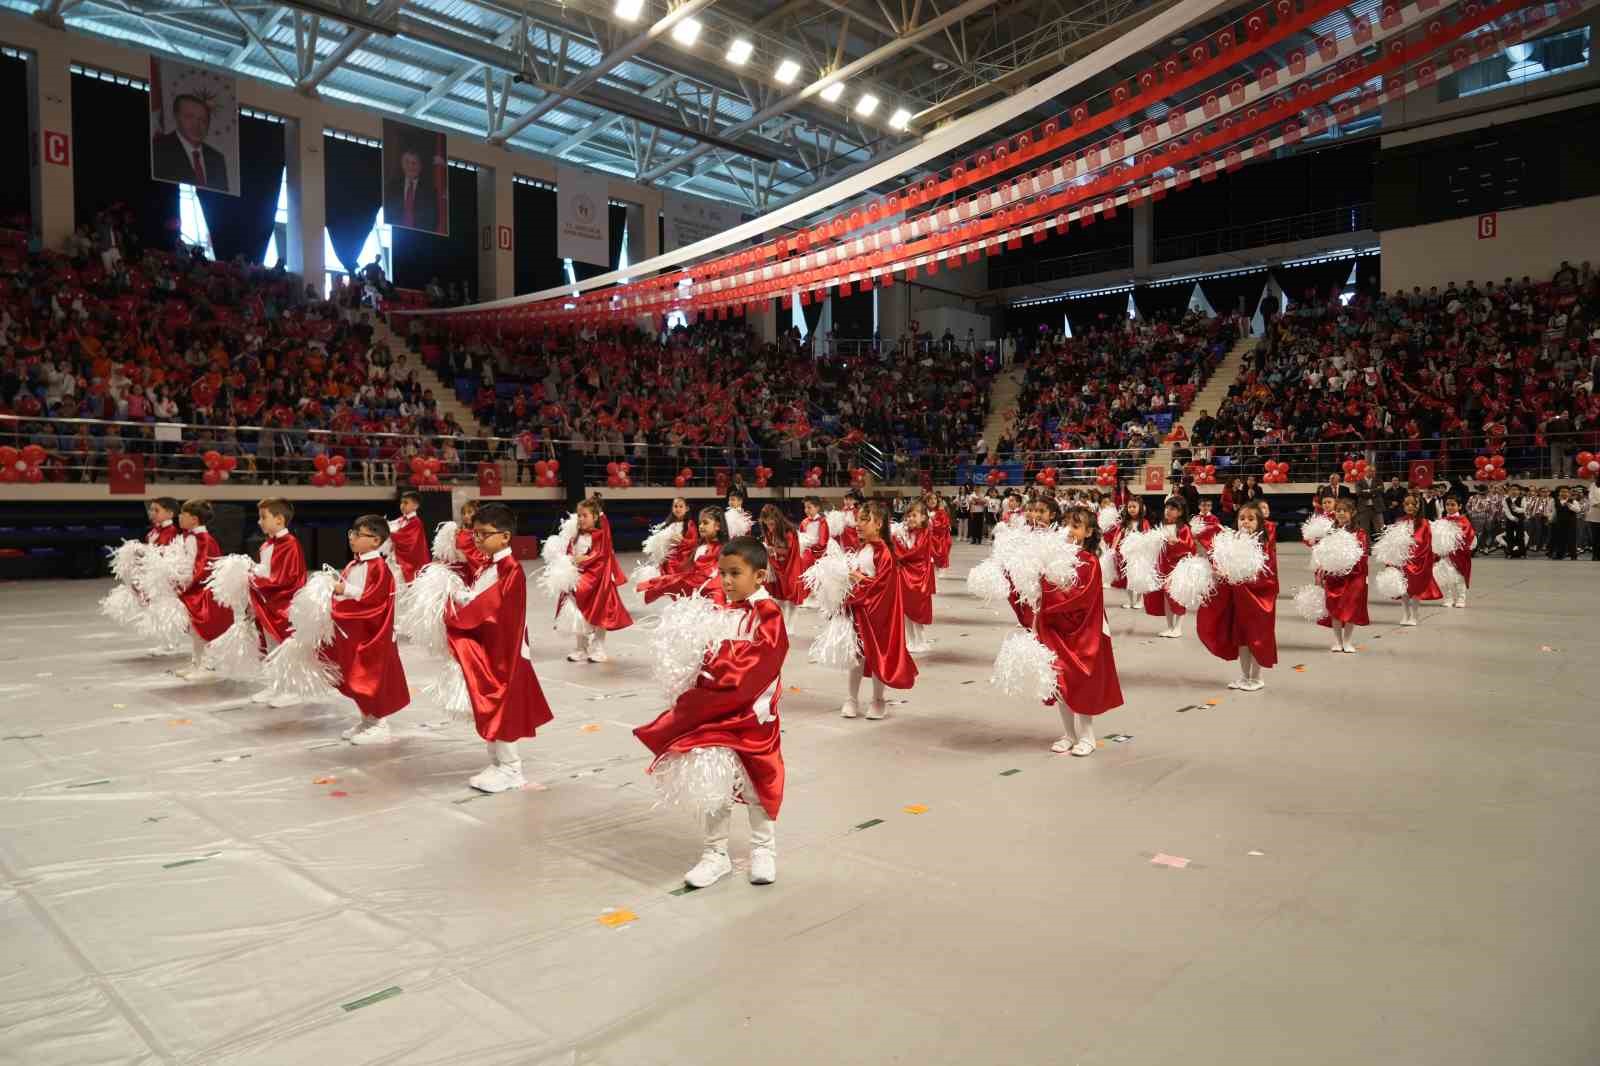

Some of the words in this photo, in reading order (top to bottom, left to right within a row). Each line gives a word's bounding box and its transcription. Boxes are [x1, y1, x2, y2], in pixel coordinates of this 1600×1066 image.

[49, 135, 64, 162] C
[1481, 216, 1493, 236] G
[500, 228, 510, 248] D
